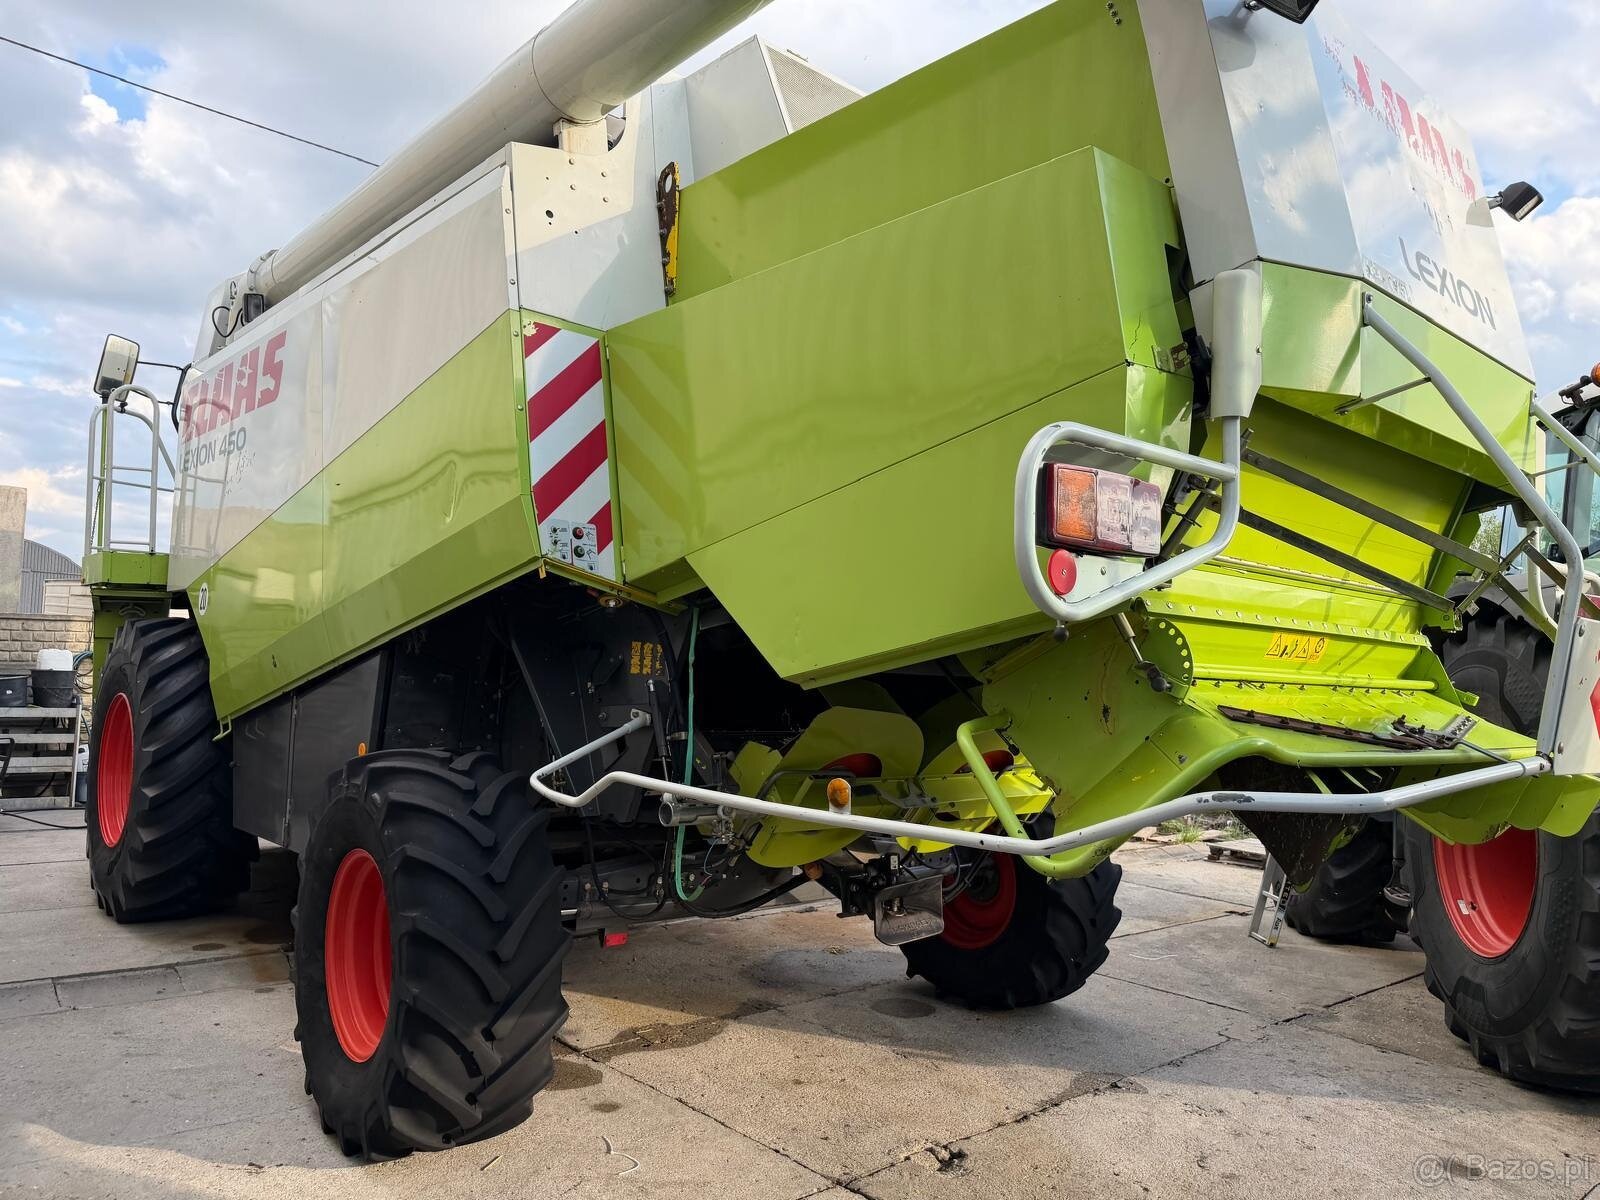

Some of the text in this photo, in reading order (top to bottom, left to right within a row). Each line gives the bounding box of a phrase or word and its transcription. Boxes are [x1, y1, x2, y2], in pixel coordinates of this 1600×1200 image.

[1398, 236, 1497, 331] LEXION
[219, 426, 247, 457] 450
[199, 586, 208, 611] 20
